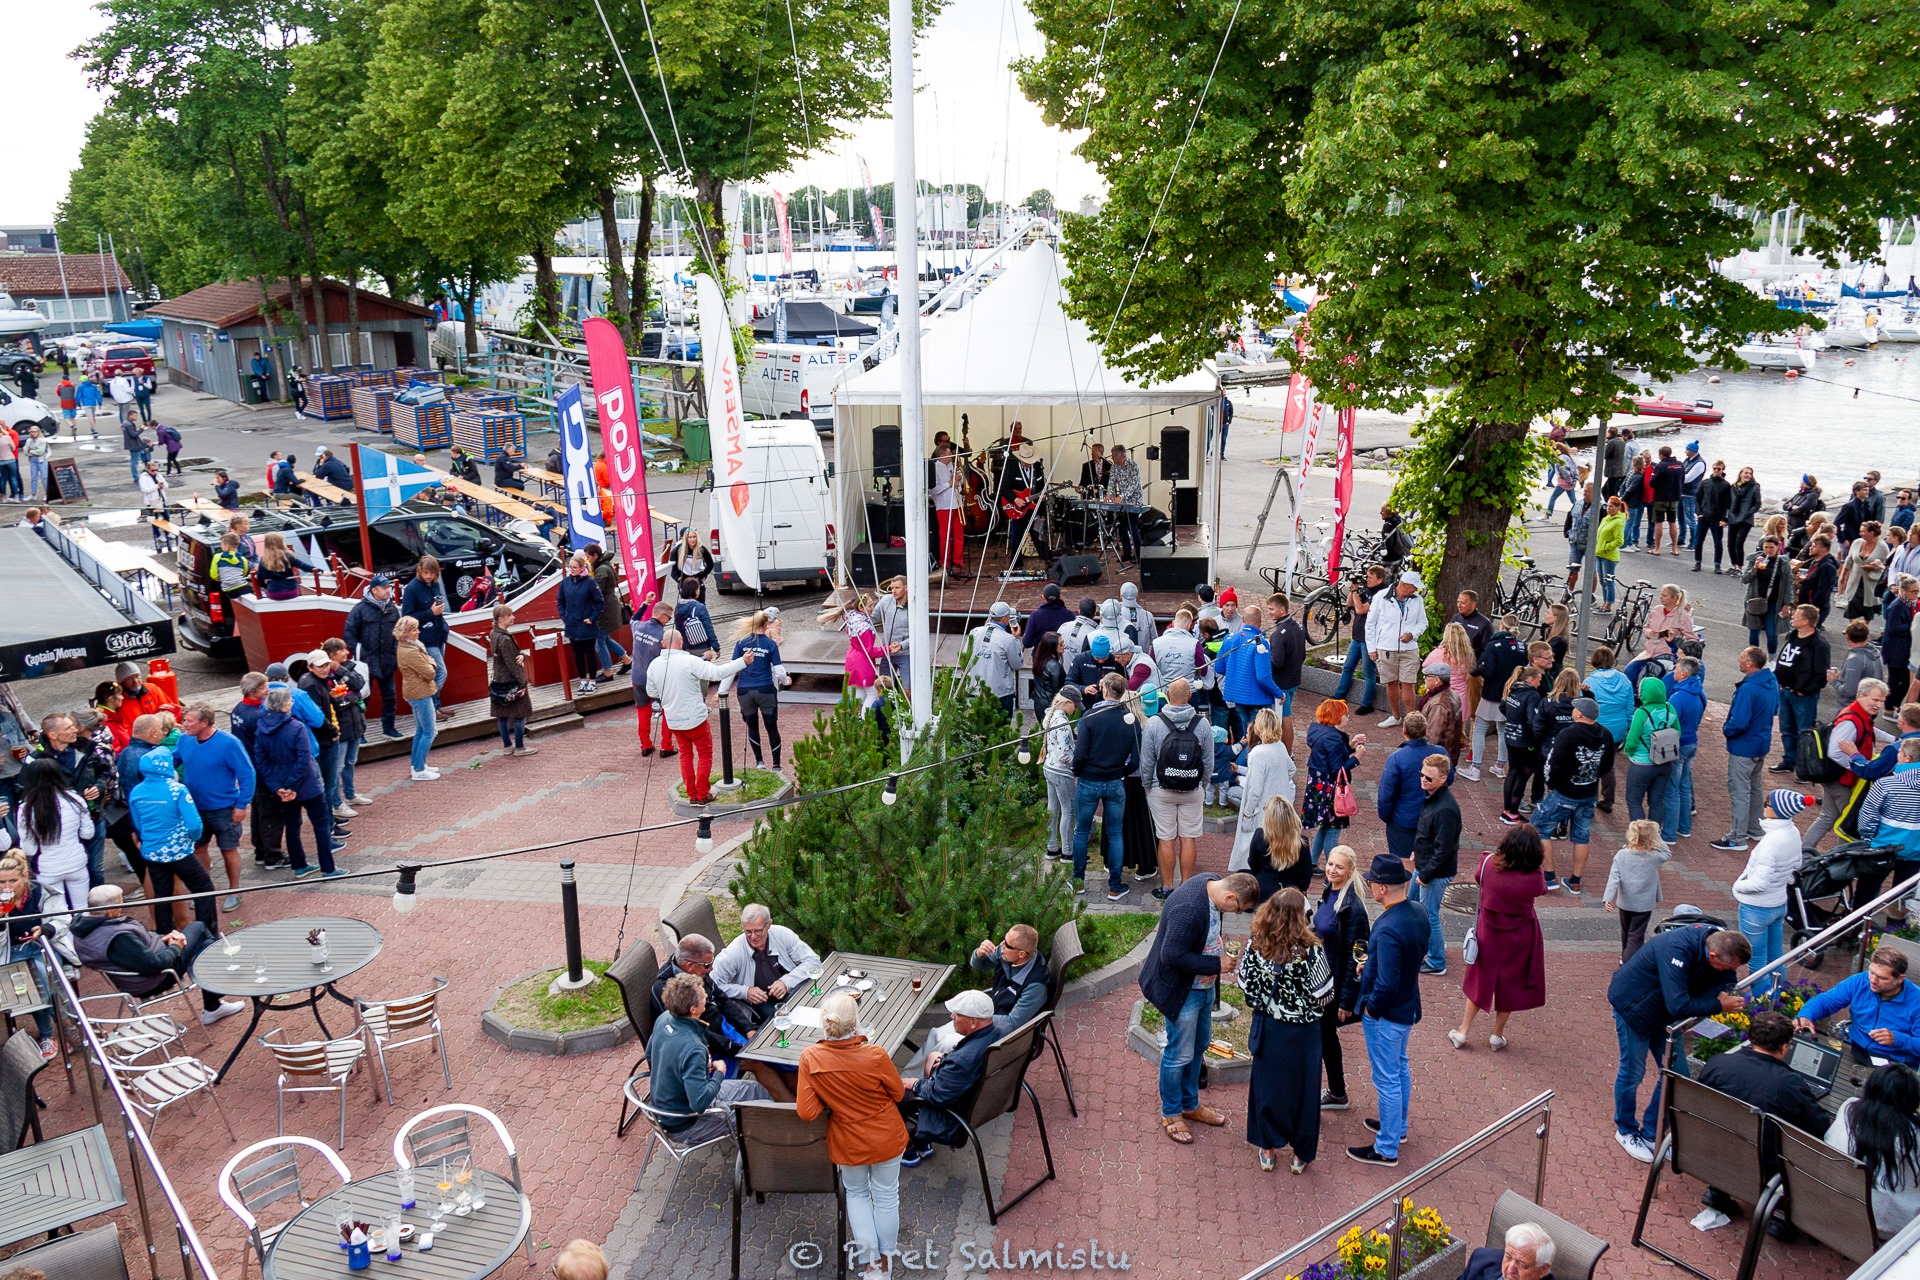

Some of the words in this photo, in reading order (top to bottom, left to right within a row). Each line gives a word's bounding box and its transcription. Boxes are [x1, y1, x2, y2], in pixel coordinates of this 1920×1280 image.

[808, 353, 858, 364] ALTER
[762, 367, 799, 383] ALTER
[111, 629, 153, 649] Black
[25, 650, 55, 667] Captain
[54, 647, 87, 662] Morgan
[117, 647, 149, 659] SPICED
